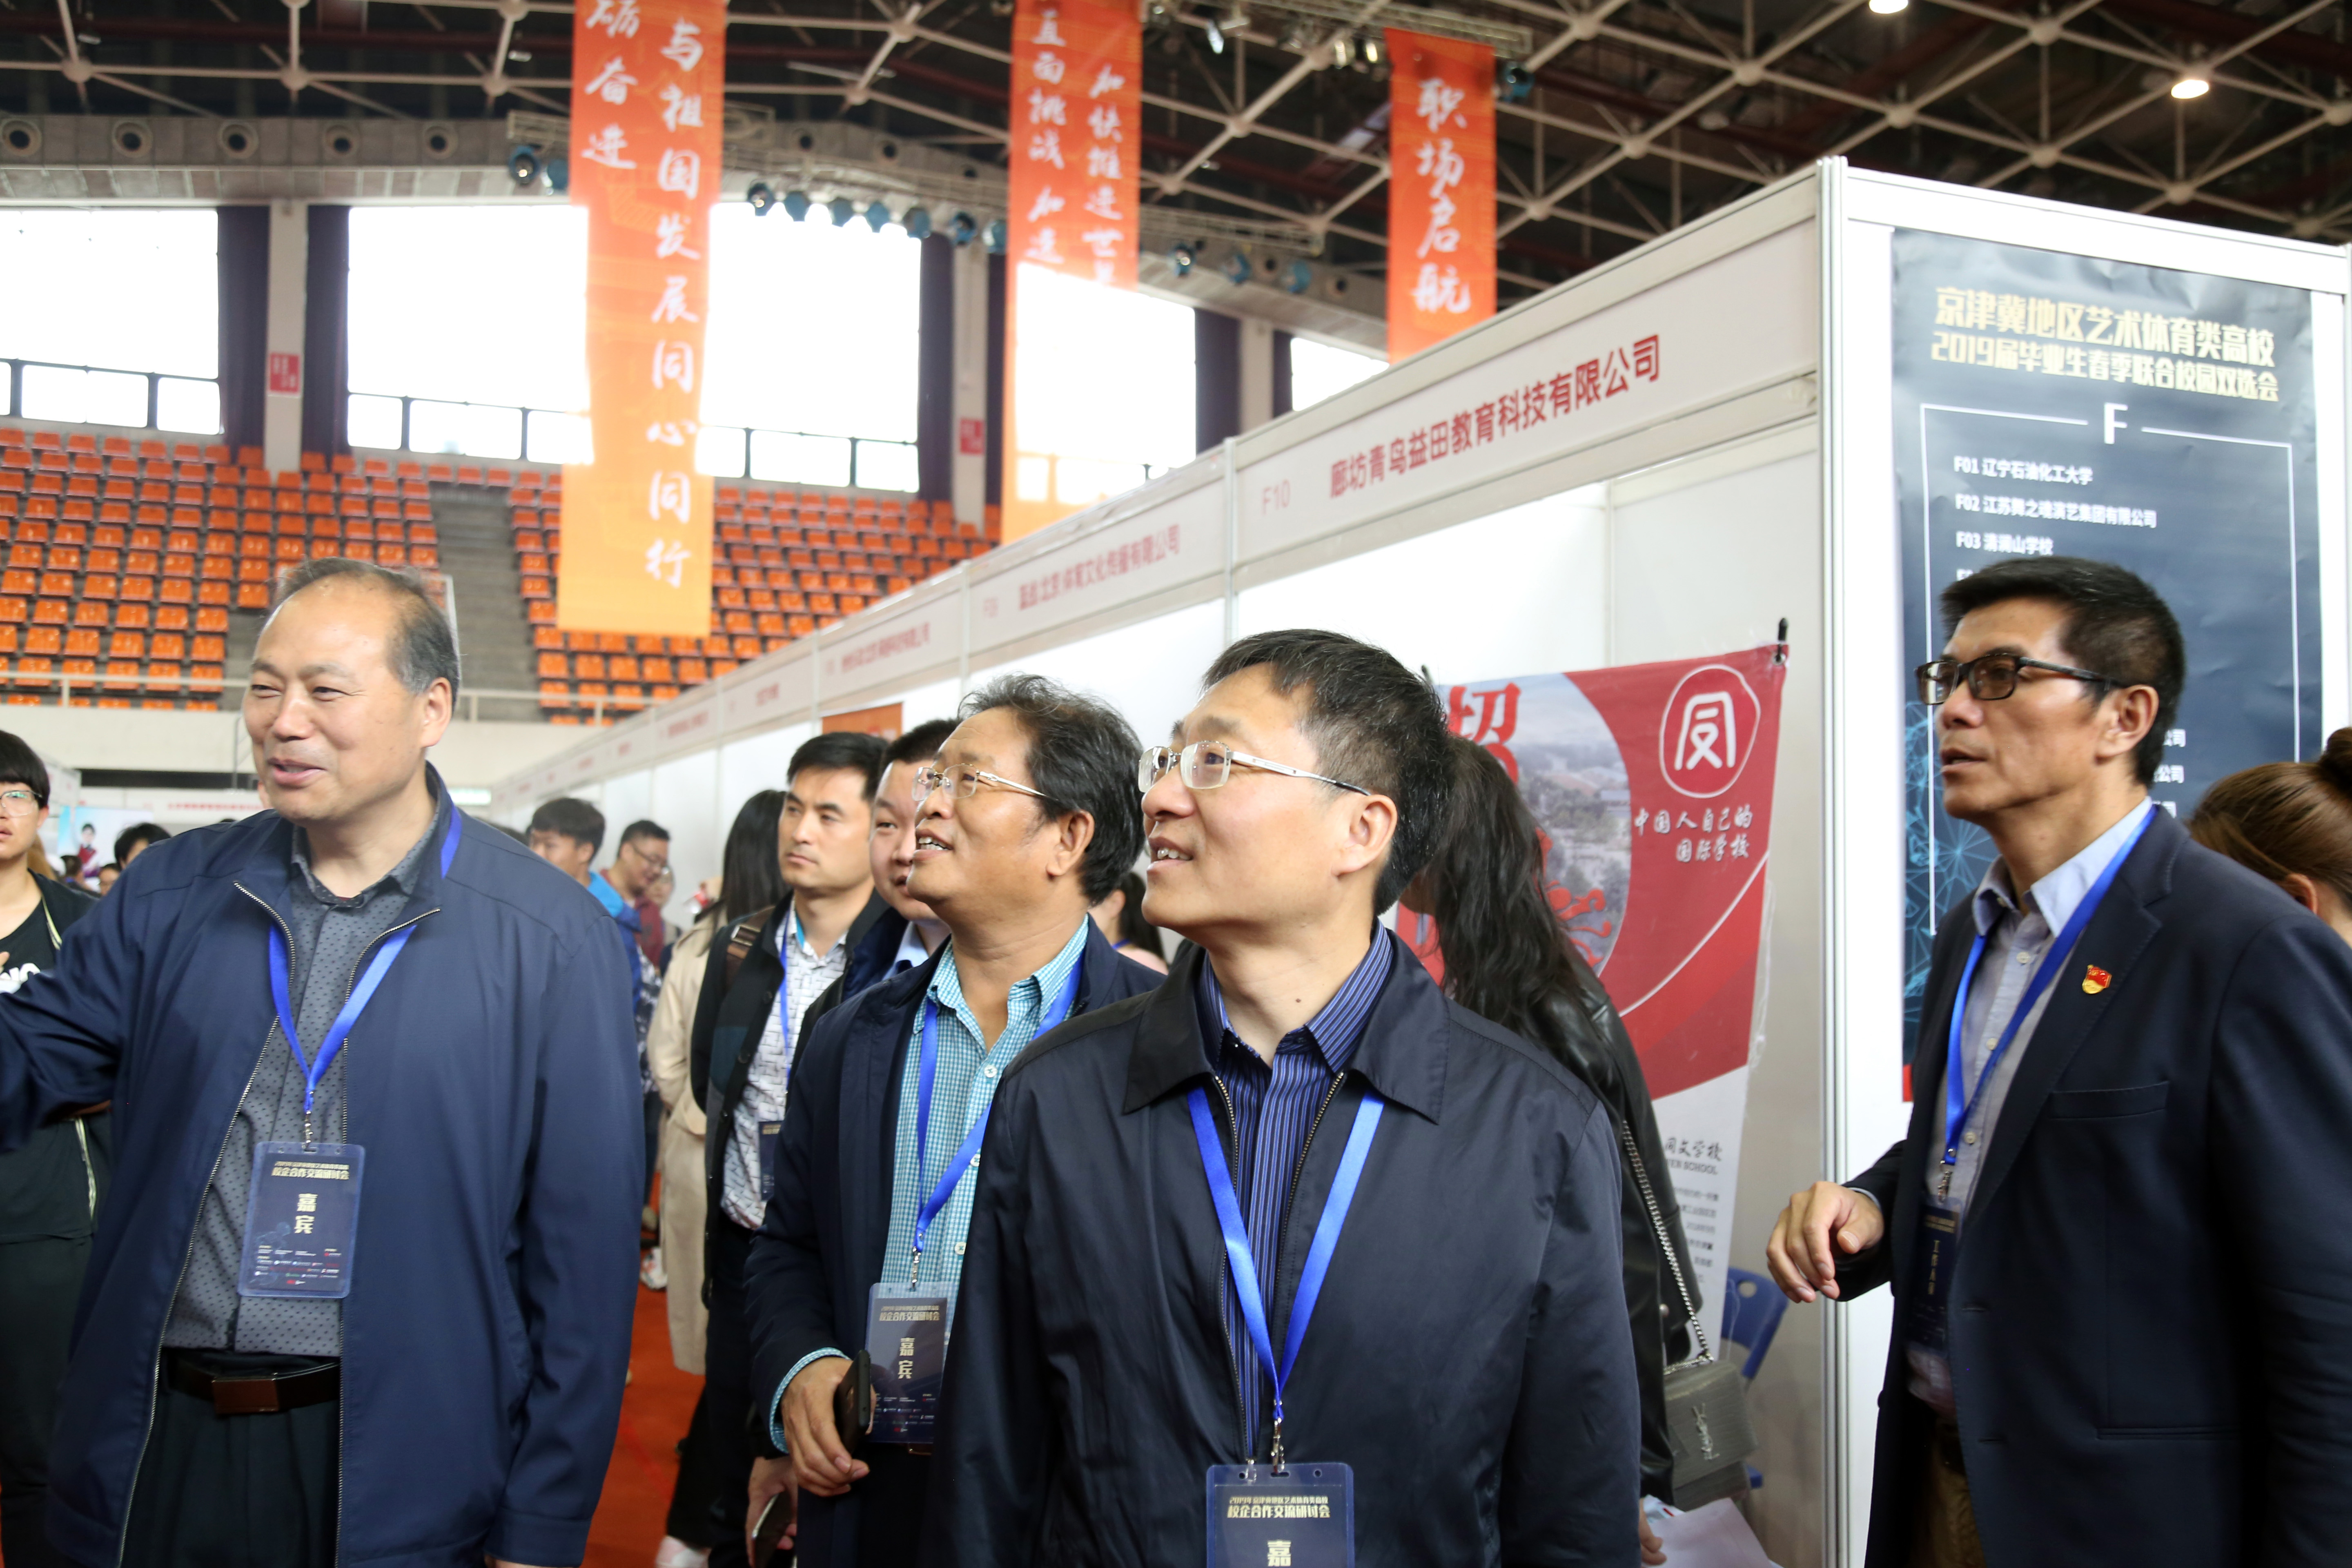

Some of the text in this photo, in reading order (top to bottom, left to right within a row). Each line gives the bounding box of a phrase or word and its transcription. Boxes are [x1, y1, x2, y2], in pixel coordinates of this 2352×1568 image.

[1411, 77, 1471, 314] 职场启航
[646, 16, 703, 589] 与祖国发展同心同行
[1936, 287, 2275, 368] 京津冀地区艺术体育类高校
[1931, 331, 2279, 402] 2019届毕业生春季联合校园双选会
[1261, 334, 1659, 515] F10 廊坊青鸟益田教育科技有限公司
[2104, 403, 2128, 445] F
[1954, 456, 2093, 485] F01 辽宁石油化工大学
[1955, 494, 1980, 512] F02
[1956, 531, 1981, 549] F03
[1634, 804, 1753, 836] 中国人自己的
[1676, 833, 1750, 863] 国际学校
[294, 1193, 318, 1234] 嘉宾
[898, 1337, 915, 1379] 嘉宾
[1227, 1505, 1330, 1518] 校企合作交流研讨会
[1267, 1538, 1292, 1567] 嘉
